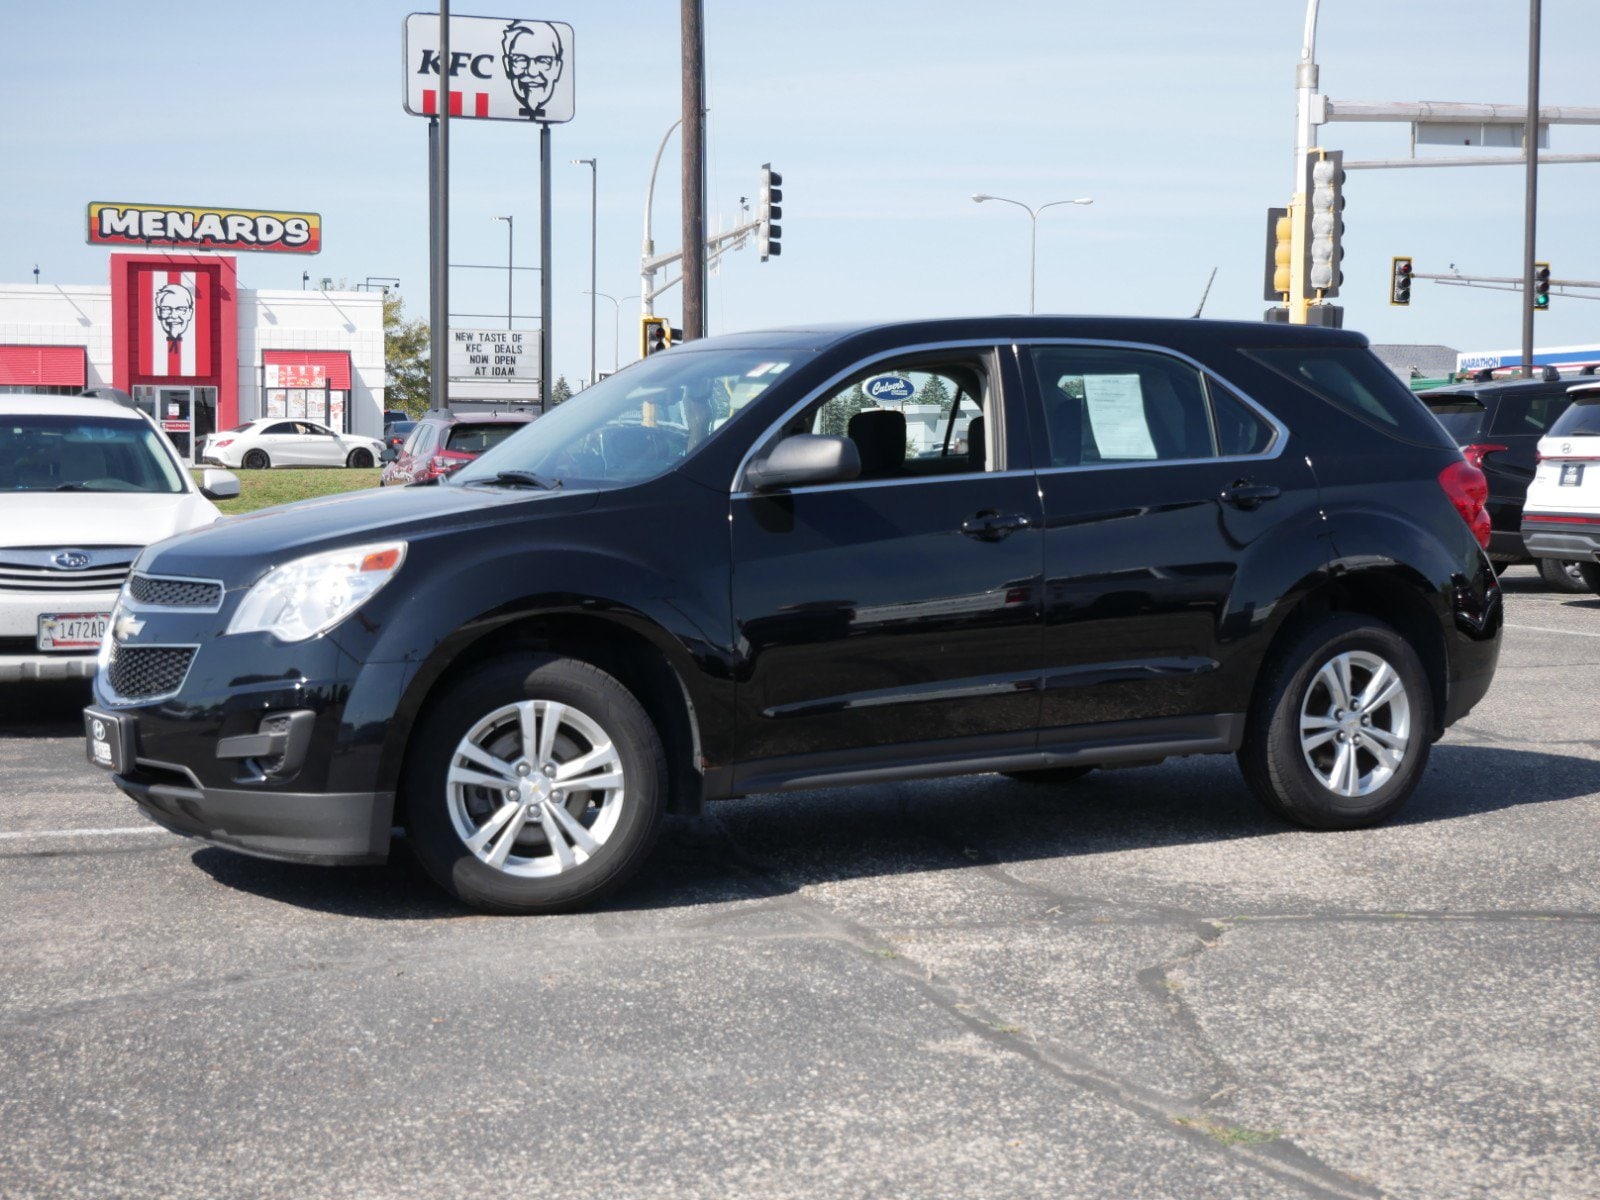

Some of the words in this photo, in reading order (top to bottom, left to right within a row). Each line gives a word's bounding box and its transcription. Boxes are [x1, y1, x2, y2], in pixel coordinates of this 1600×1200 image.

[417, 49, 494, 79] KFC
[98, 207, 311, 247] MENARDS
[455, 332, 474, 342] NEW
[479, 333, 507, 342] TASTE
[512, 334, 523, 343] OF
[466, 343, 482, 353] KFC
[494, 344, 523, 354] DEALS
[469, 354, 489, 364] NOW
[494, 355, 516, 365] OPEN
[1460, 357, 1500, 369] MARATHON
[474, 366, 487, 376] AT
